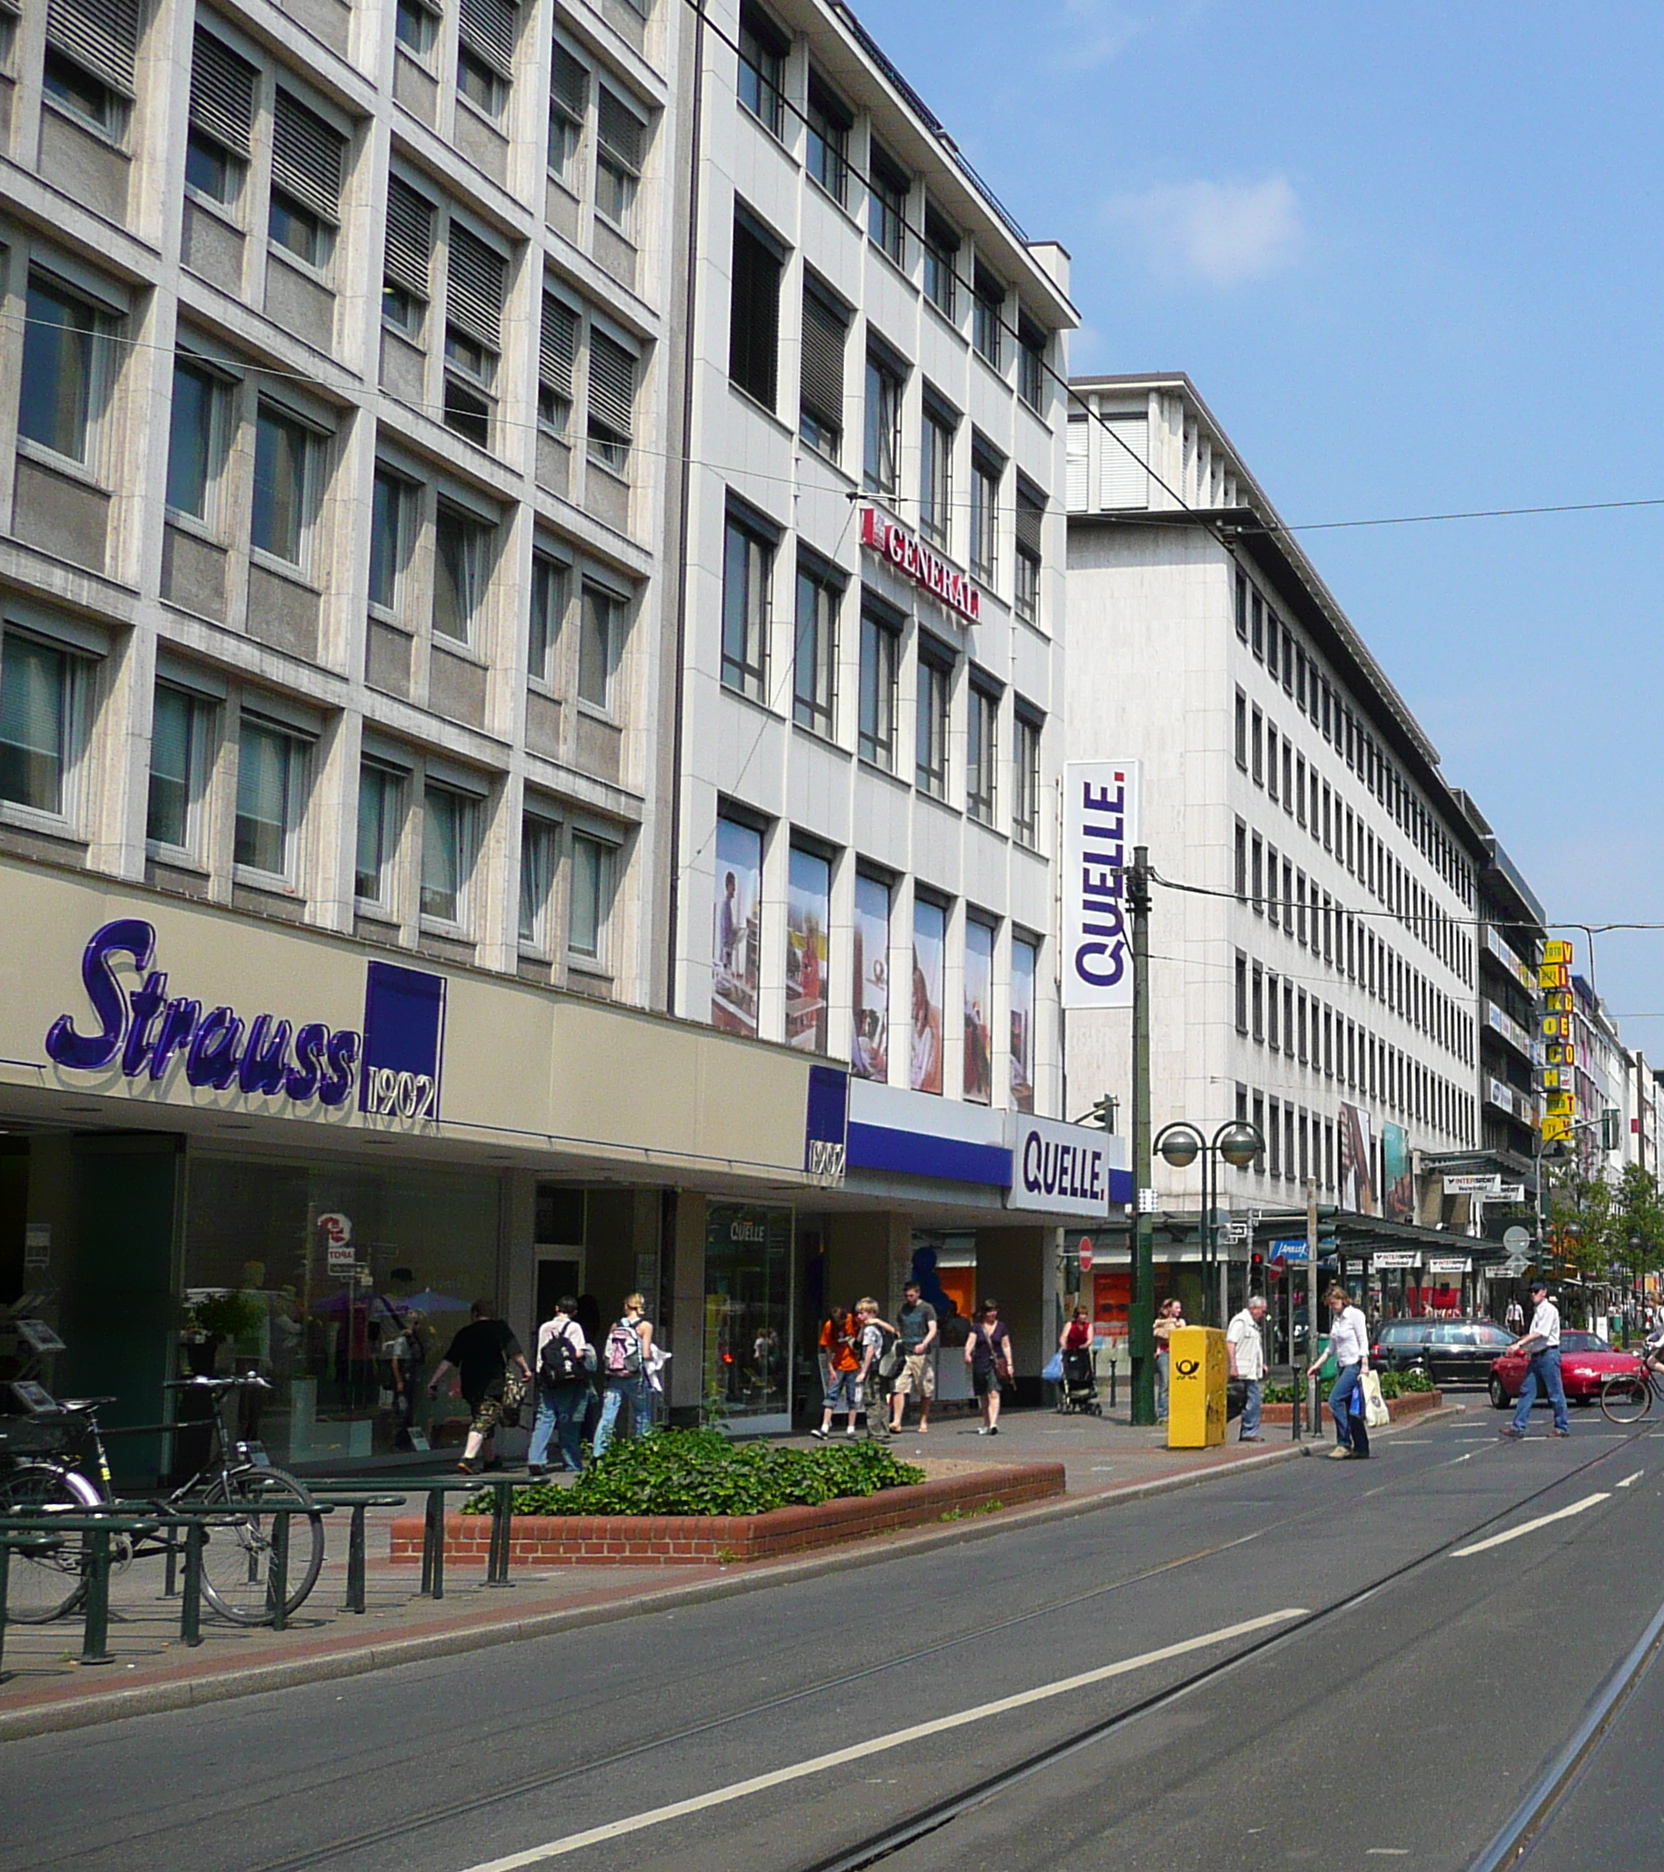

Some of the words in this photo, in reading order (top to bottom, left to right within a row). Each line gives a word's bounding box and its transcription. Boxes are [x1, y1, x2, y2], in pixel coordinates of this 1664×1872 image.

[889, 525, 981, 621] GENERALI
[45, 918, 363, 1106] Strauss
[1542, 992, 1562, 1087] KOCH
[367, 1065, 437, 1121] 1902
[730, 1221, 766, 1242] QUELLE
